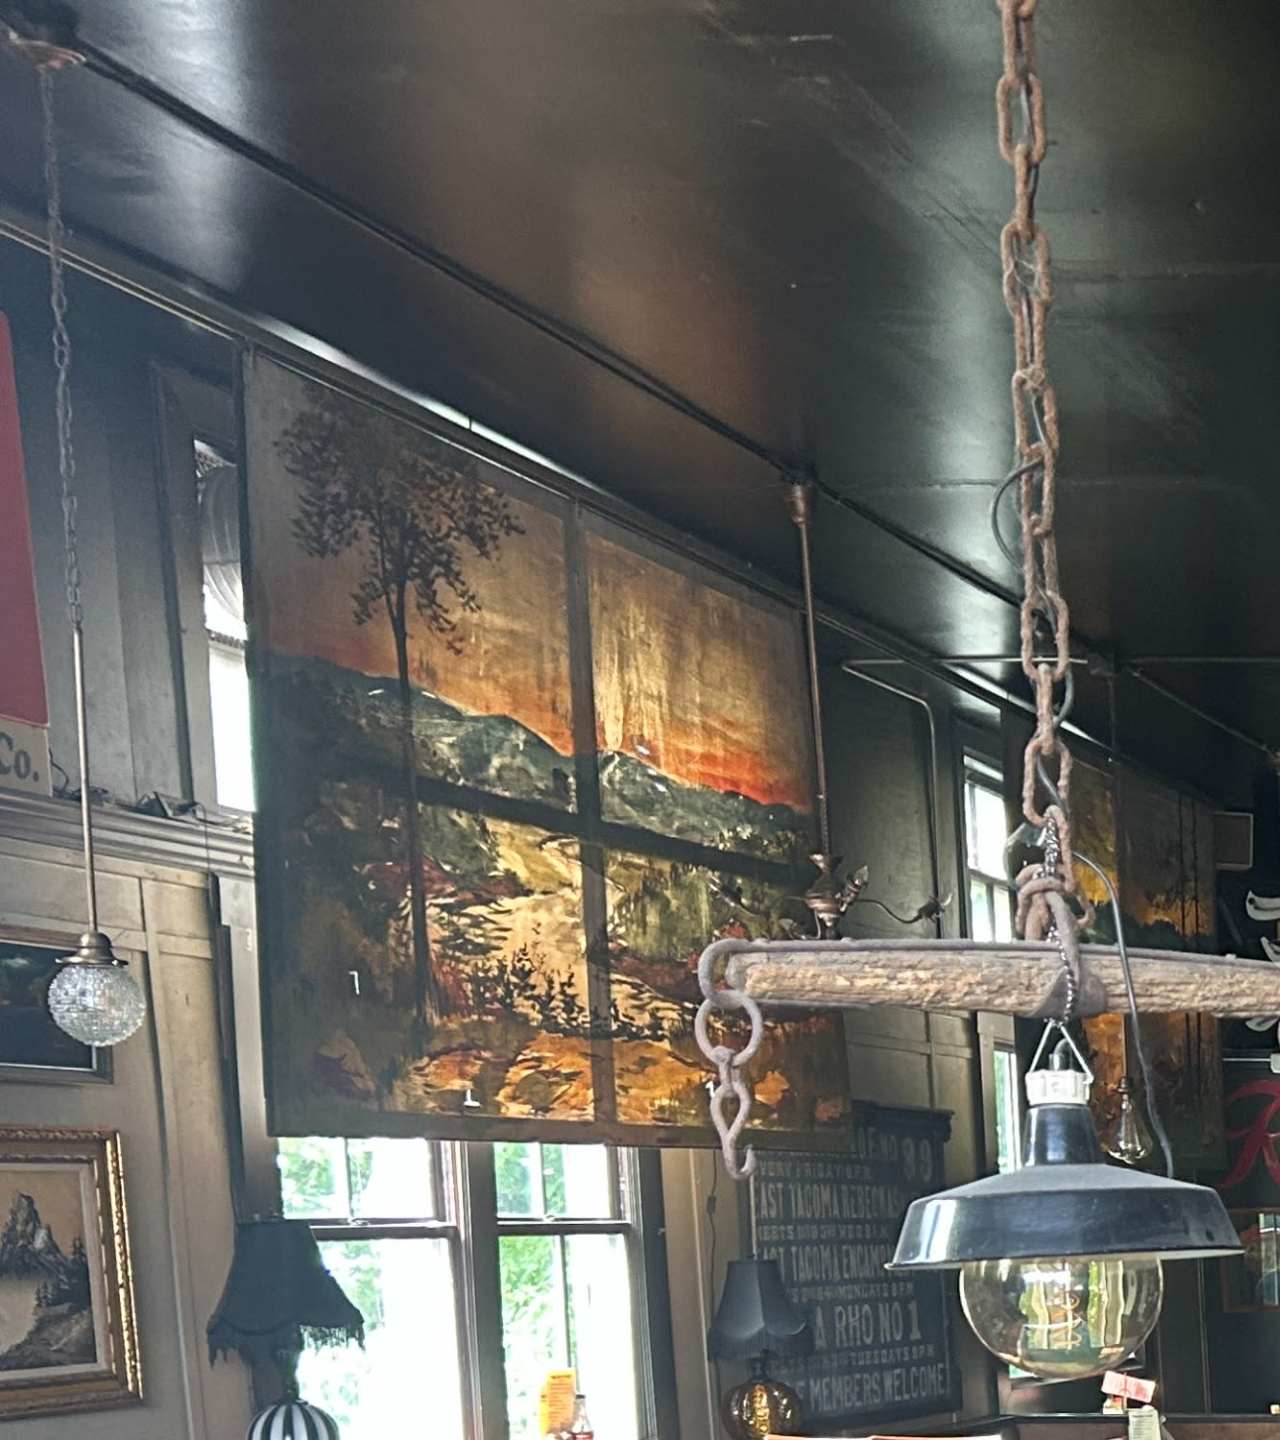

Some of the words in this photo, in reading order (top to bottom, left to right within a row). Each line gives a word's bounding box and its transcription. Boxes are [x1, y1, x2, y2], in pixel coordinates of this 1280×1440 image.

[757, 1182, 783, 1219] AST
[788, 1182, 840, 1219] TACOMA
[789, 1245, 840, 1282] TACOMA
[834, 1302, 874, 1347] RHO
[878, 1301, 904, 1344] NO
[909, 1299, 922, 1341] 1
[808, 1369, 881, 1413] MEMBERS
[883, 1362, 945, 1402] WELCOME
